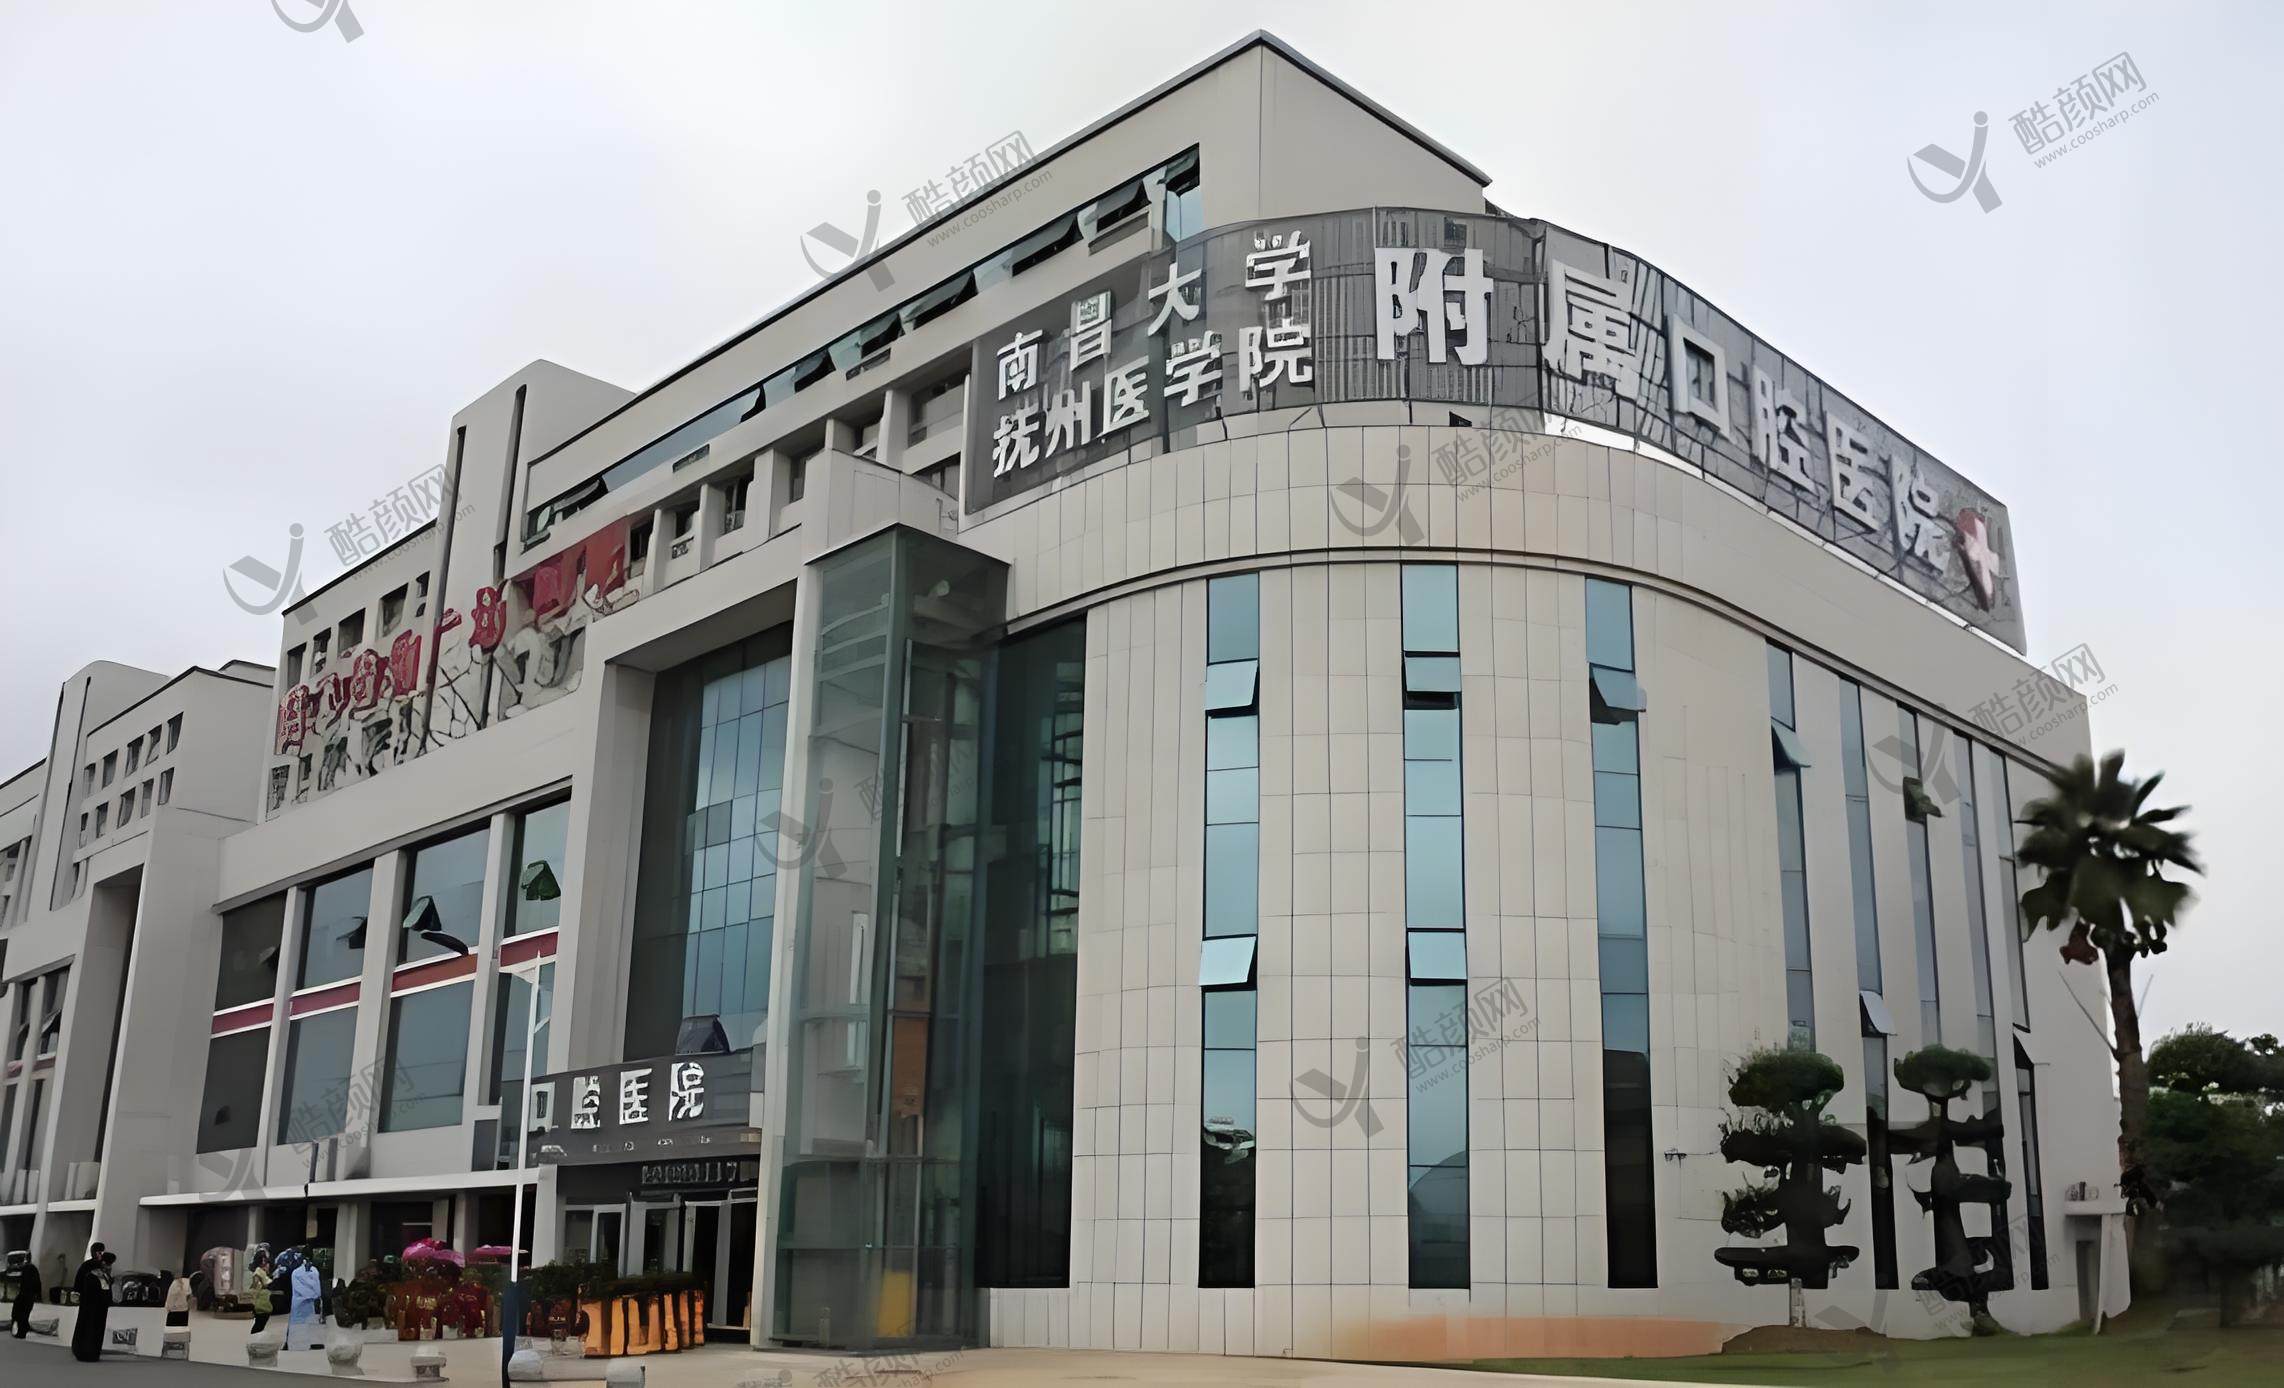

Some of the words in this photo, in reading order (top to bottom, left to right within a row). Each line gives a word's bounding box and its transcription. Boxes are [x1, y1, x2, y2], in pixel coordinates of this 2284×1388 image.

[991, 318, 1314, 479] 抚州医学院
[995, 229, 1312, 400] 南昌大学
[1374, 246, 1953, 574] 附属口腔医院
